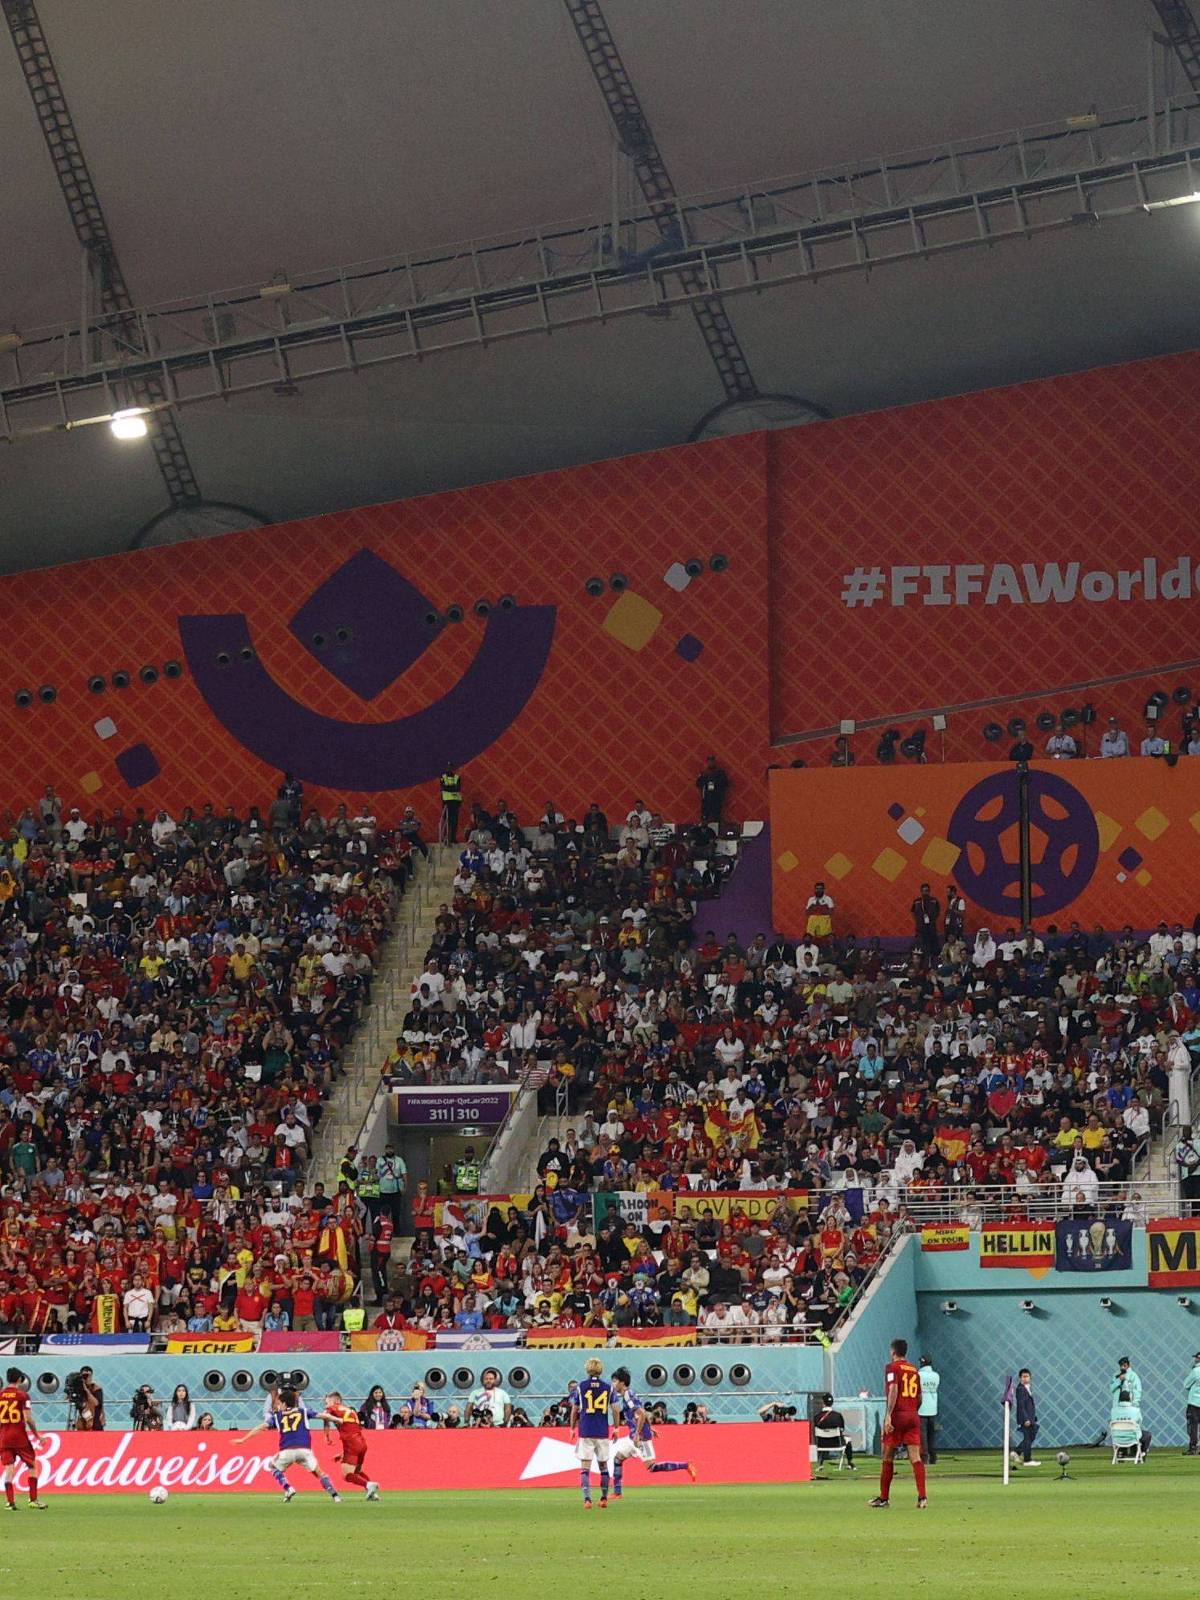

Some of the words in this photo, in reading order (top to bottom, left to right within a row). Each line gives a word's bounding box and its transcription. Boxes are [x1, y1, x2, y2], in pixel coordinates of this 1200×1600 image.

[902, 1372, 918, 1398] 16
[0, 1400, 21, 1424] 26
[584, 1389, 609, 1414] 14
[280, 1412, 302, 1432] 17
